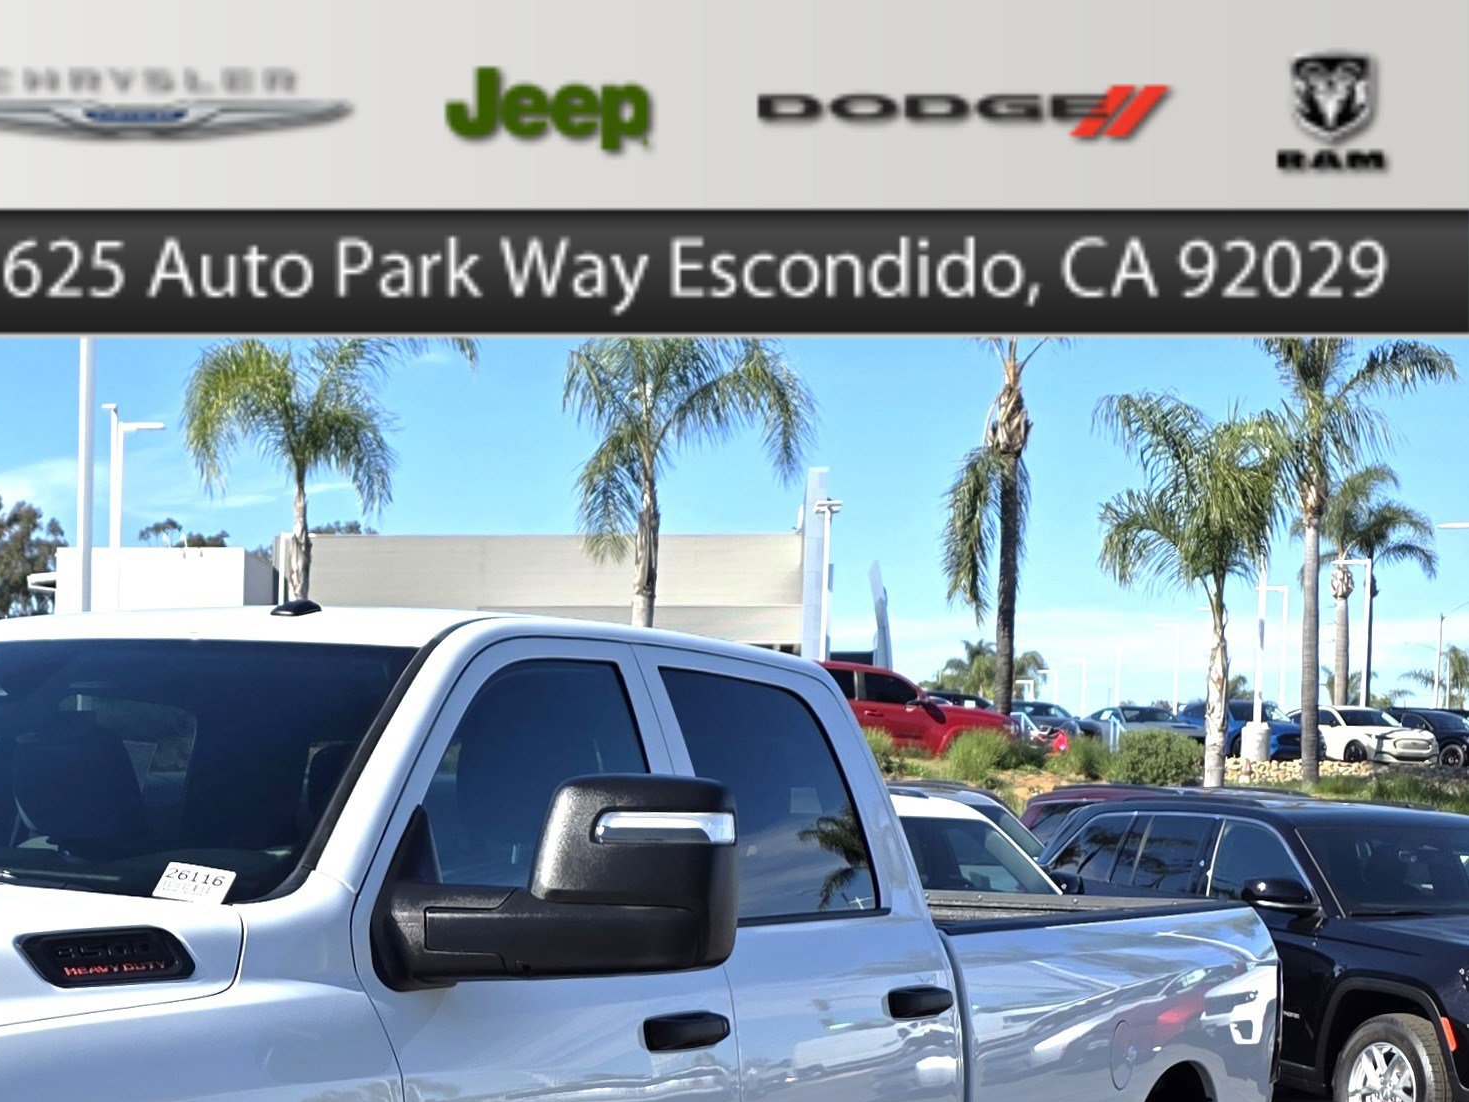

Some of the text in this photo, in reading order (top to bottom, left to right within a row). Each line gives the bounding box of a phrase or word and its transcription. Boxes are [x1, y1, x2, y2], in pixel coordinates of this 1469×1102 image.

[165, 867, 226, 887] 26116
[63, 960, 166, 977] HEAVY DUTY
